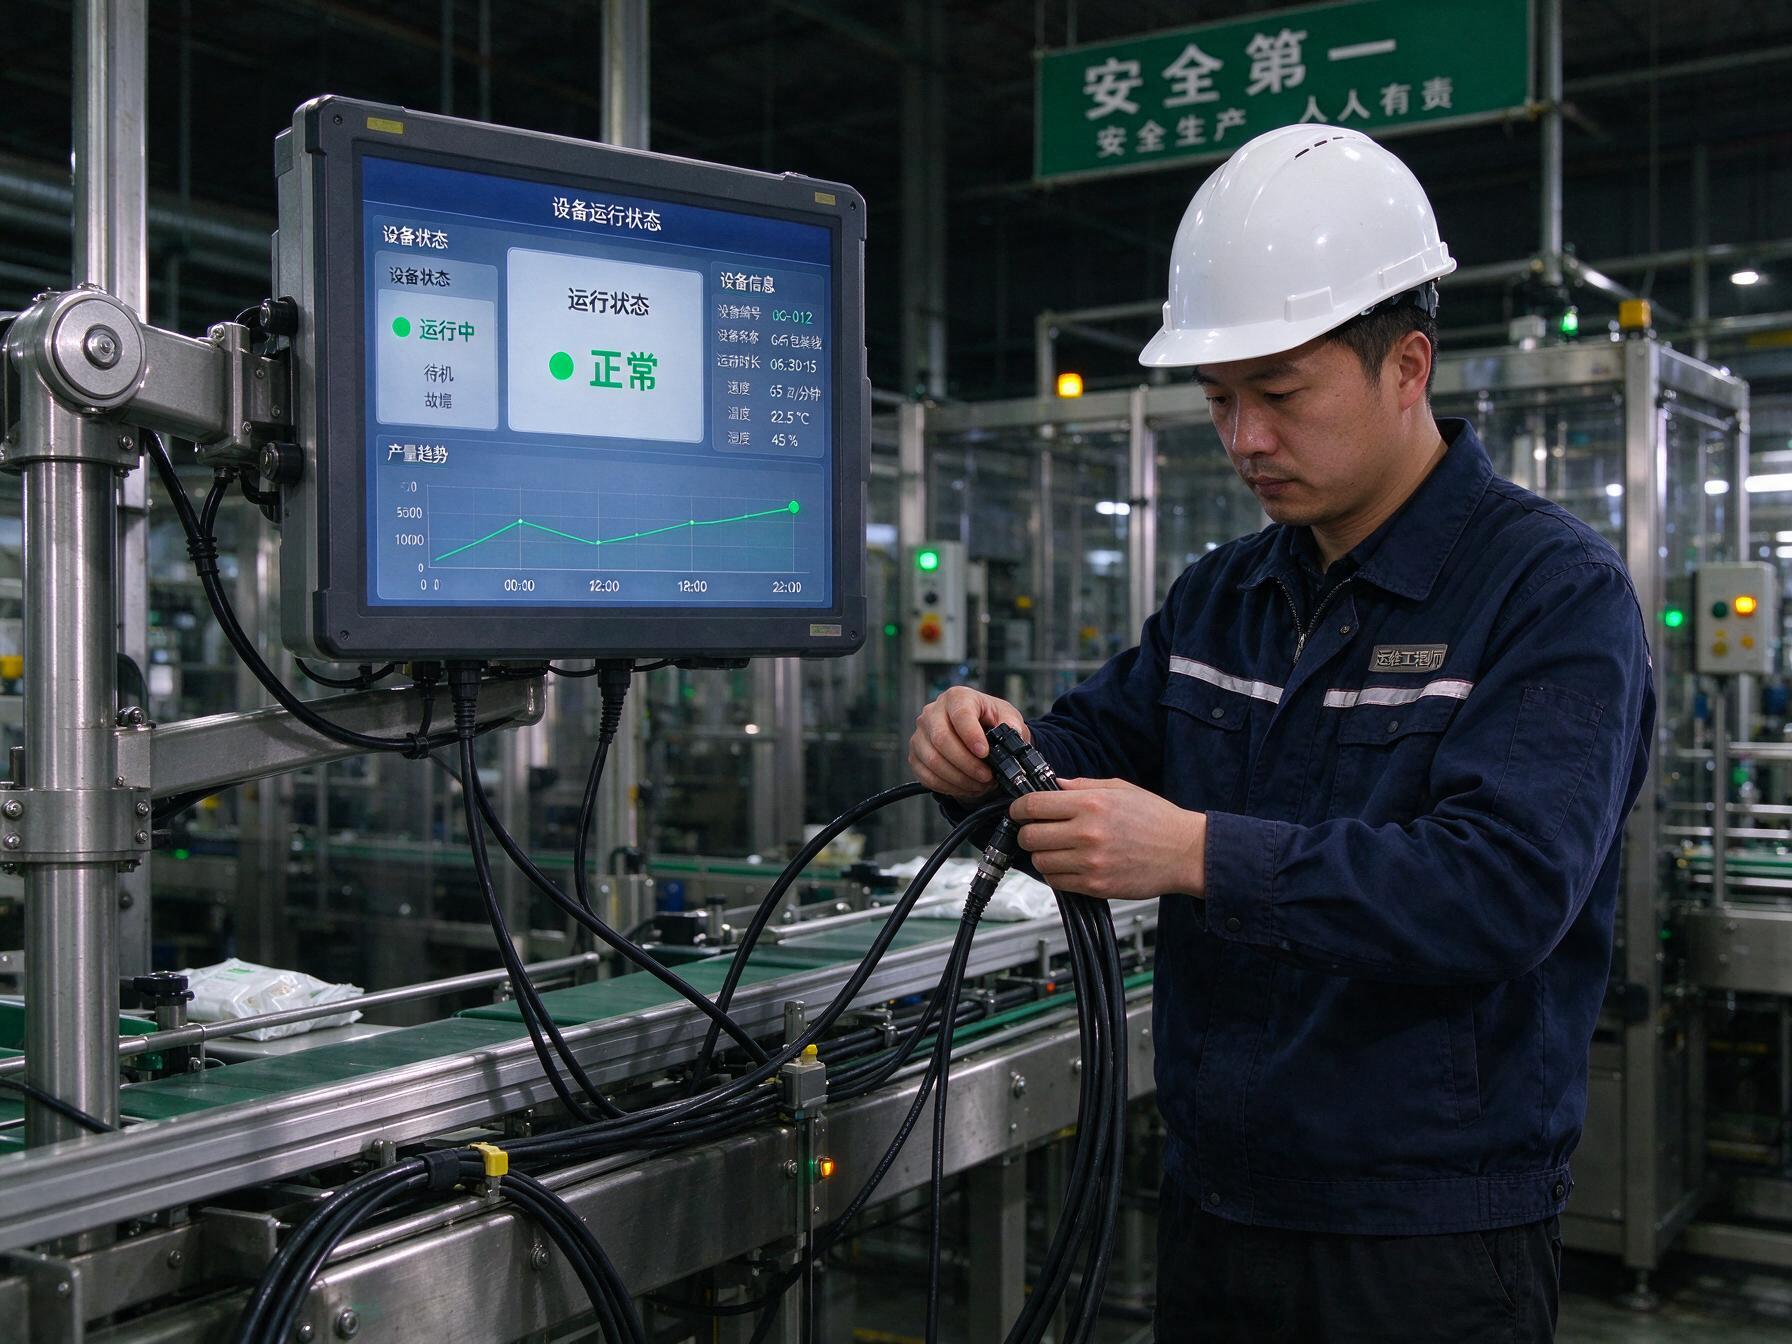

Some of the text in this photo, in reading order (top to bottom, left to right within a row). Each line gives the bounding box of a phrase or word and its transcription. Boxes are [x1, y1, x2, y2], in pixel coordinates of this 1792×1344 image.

[1083, 28, 1396, 120] 安全第一
[1096, 77, 1454, 159] 安全生产 人人有责
[553, 196, 662, 231] 设备运行状态
[383, 225, 448, 249] 设备状态
[389, 266, 451, 287] 设备状态
[720, 271, 775, 293] 设备信息
[568, 288, 650, 316] 运行状态
[419, 318, 475, 342] 运行中
[424, 363, 454, 383] 待机
[589, 349, 658, 391] 正常
[769, 384, 783, 398] 65
[387, 443, 449, 463] 产量趋势
